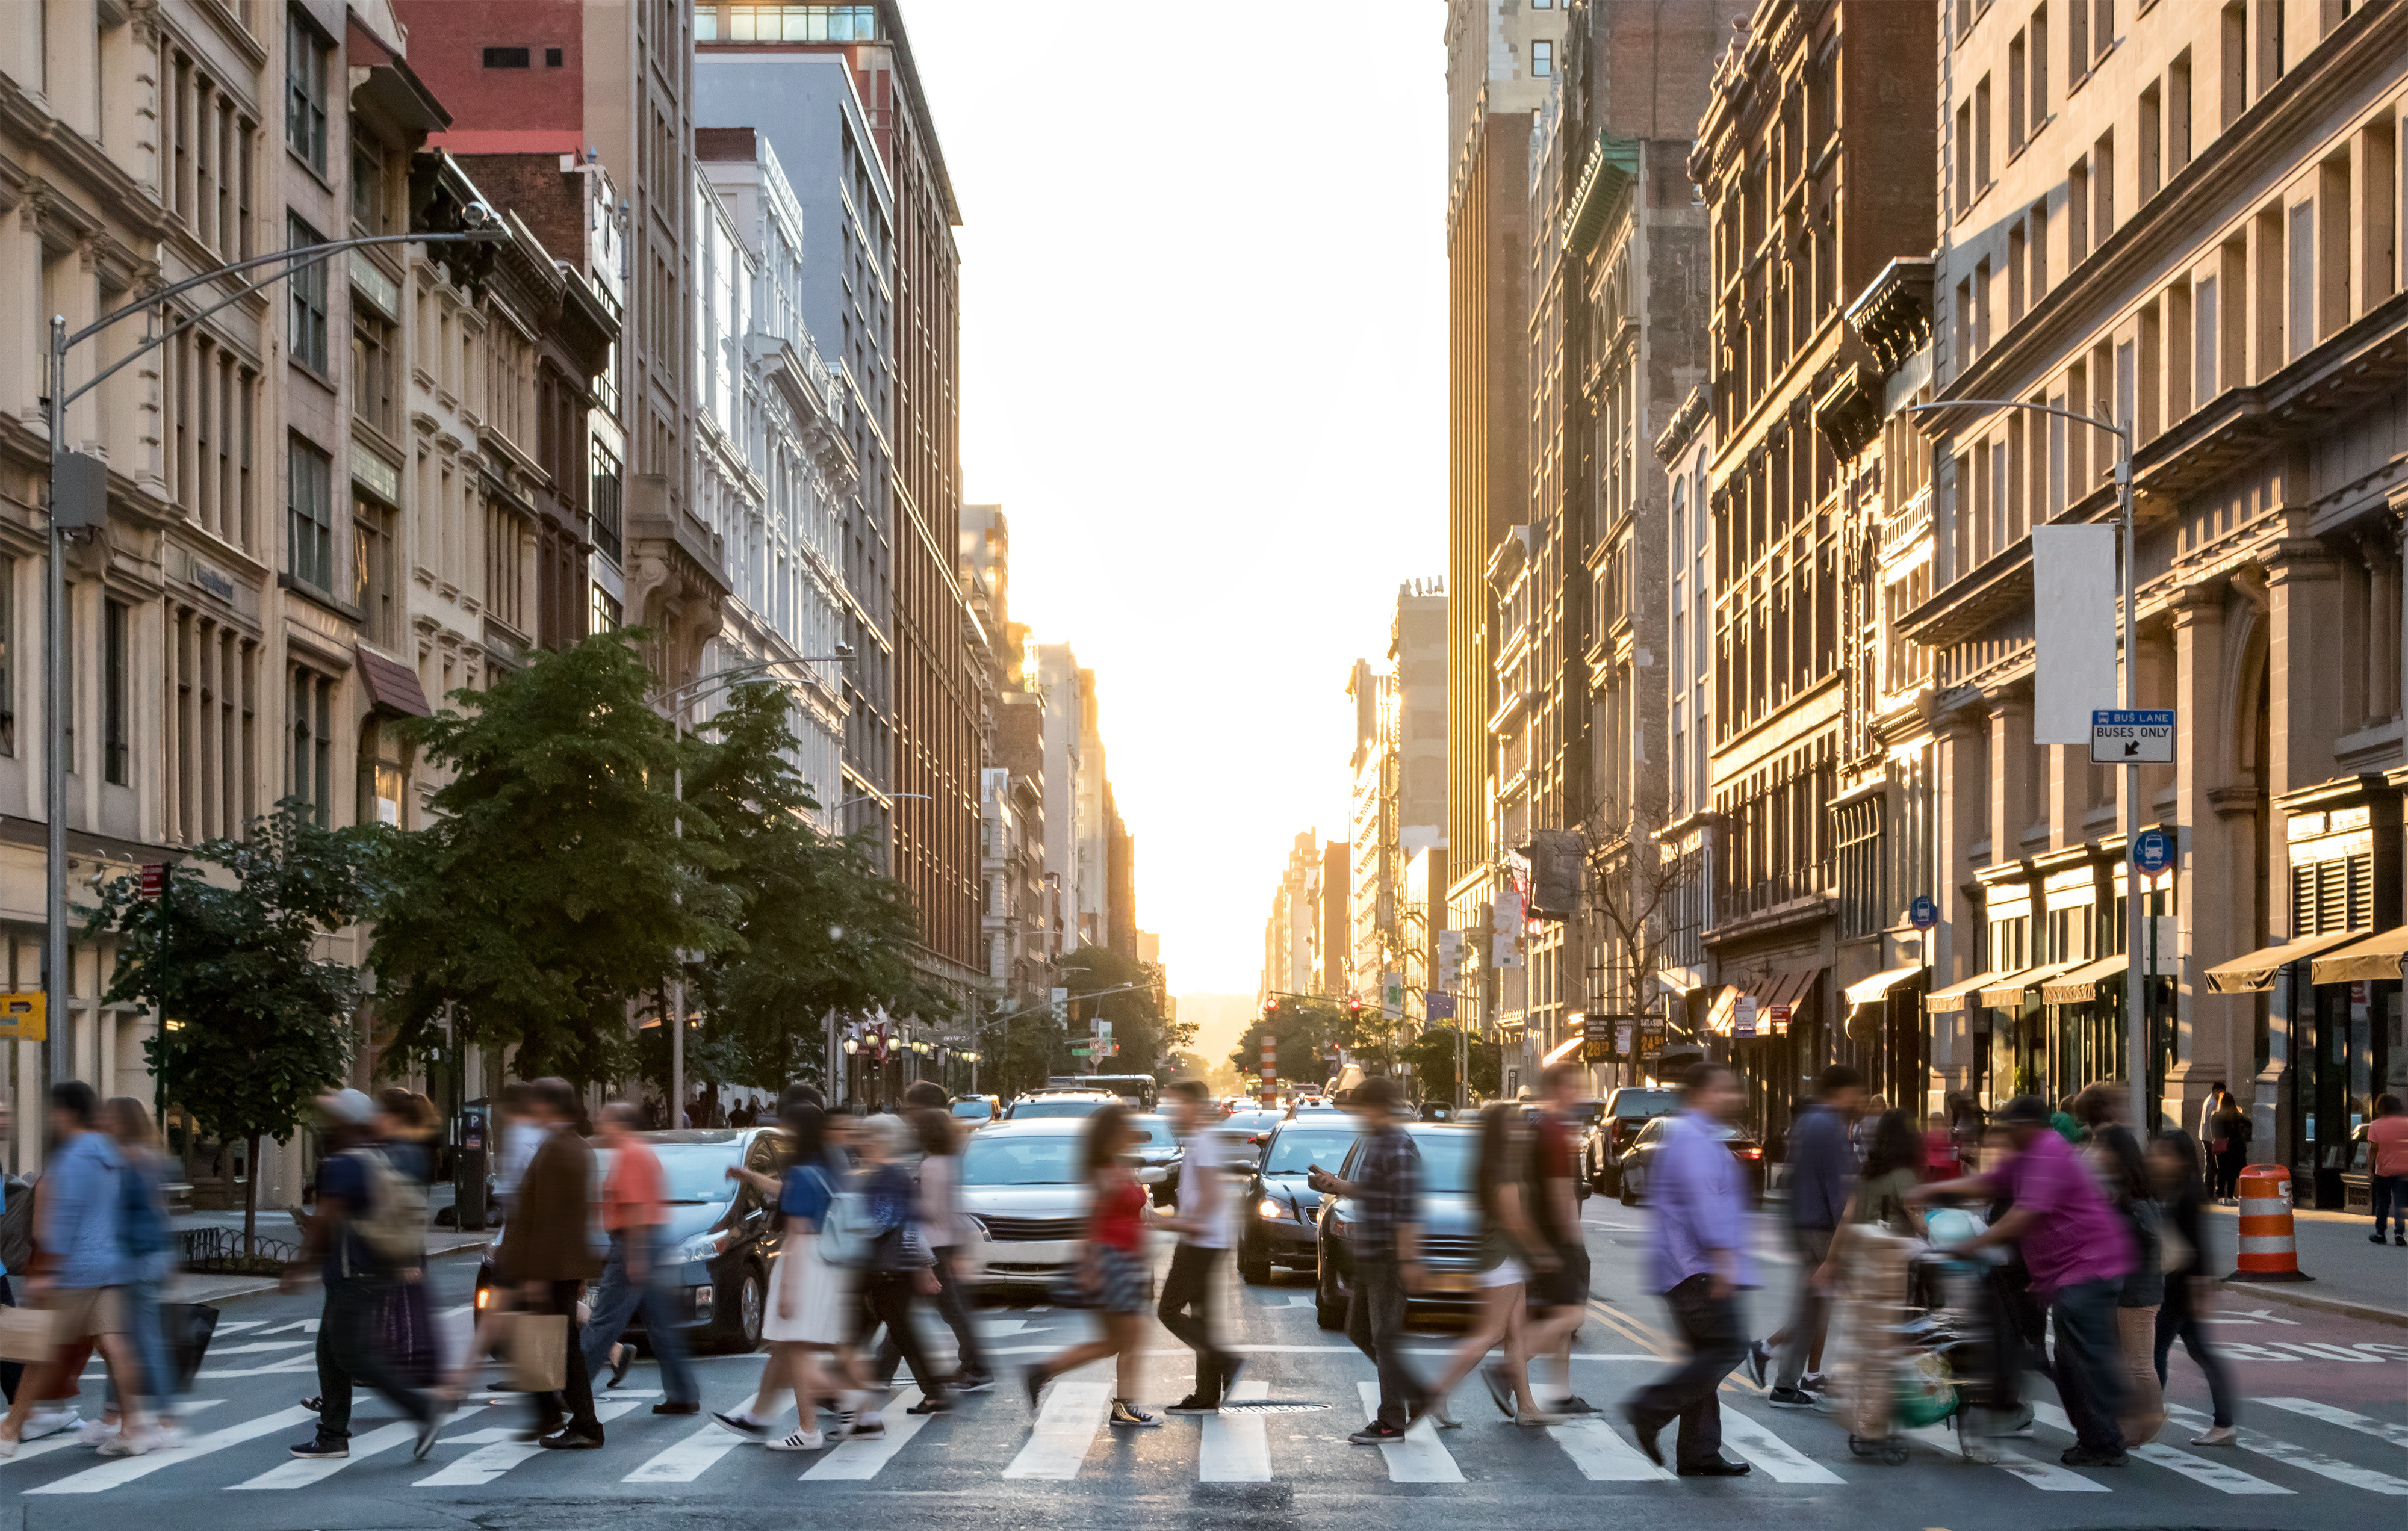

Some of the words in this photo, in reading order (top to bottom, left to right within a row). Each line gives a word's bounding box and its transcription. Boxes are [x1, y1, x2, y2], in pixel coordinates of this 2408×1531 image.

[2114, 713, 2135, 722] BUS
[2139, 714, 2169, 723] LANE
[2096, 727, 2135, 738] BUSES
[2140, 727, 2169, 738] ONLY
[471, 1115, 479, 1127] P
